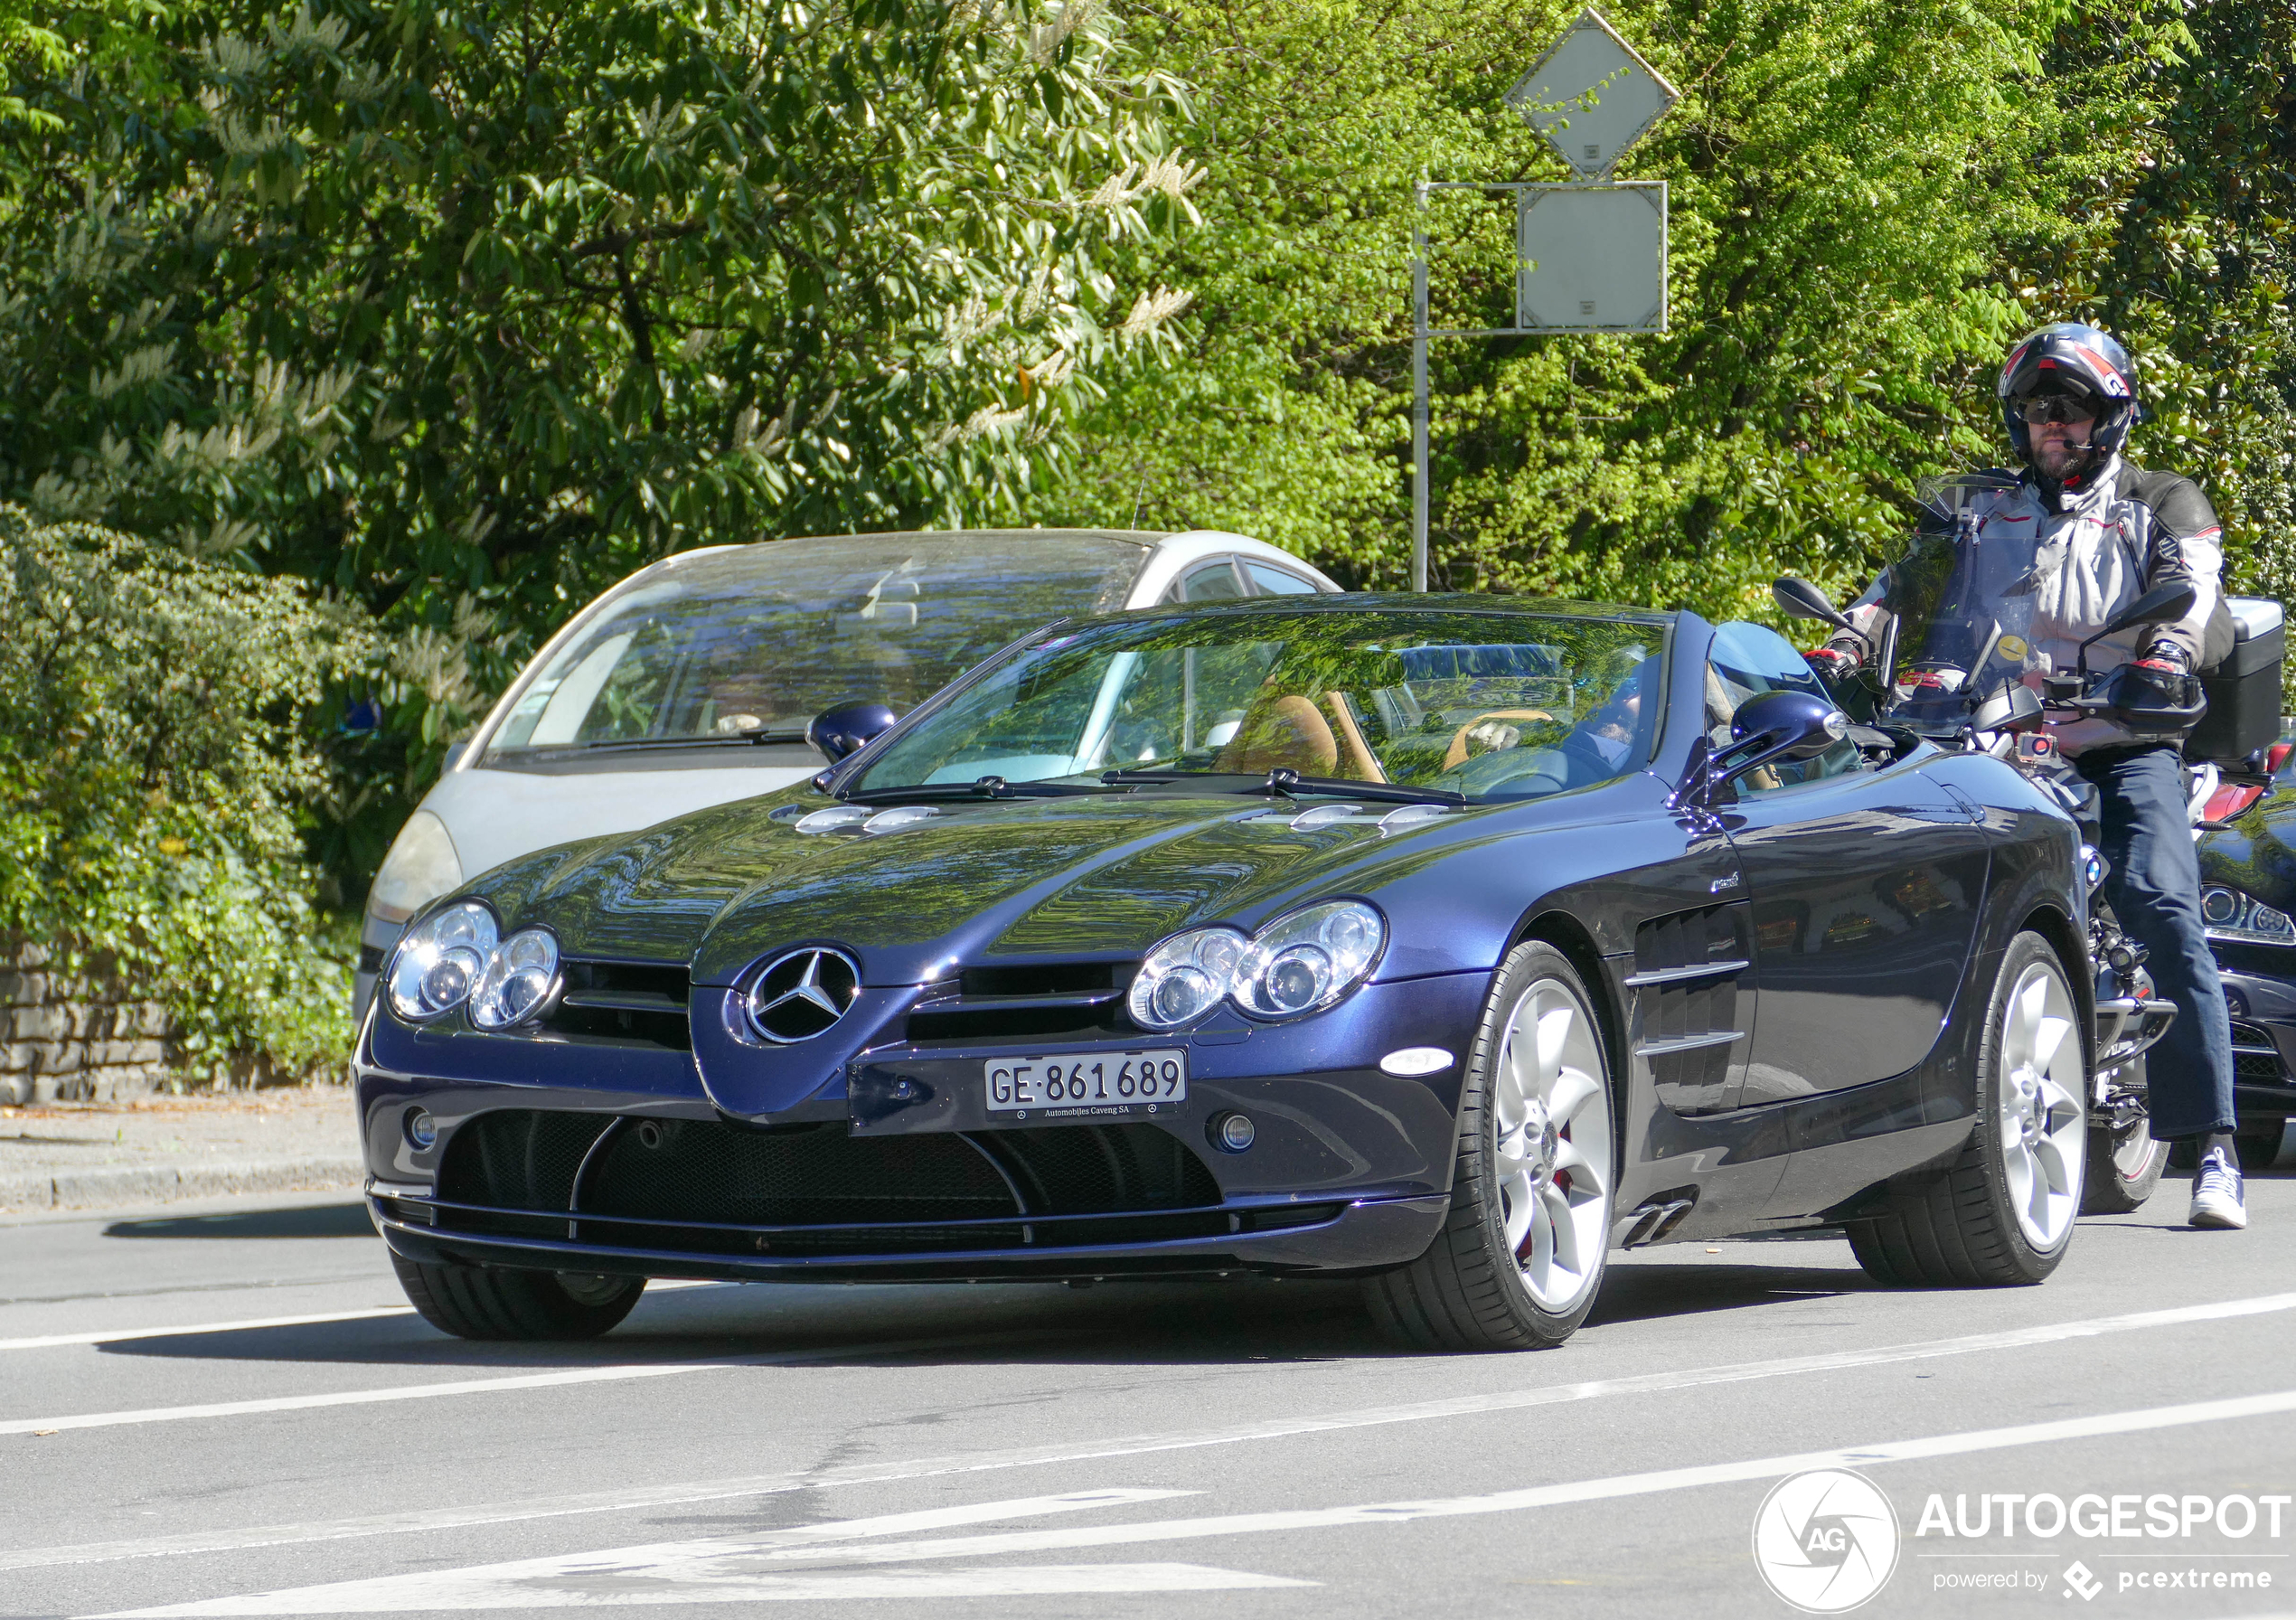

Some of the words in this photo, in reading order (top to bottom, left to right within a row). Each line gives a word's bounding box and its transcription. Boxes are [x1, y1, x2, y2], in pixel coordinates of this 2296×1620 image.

[1045, 1107, 1090, 1117] Automobiles
[1090, 1107, 1117, 1116] Caveng
[1118, 1105, 1130, 1114] SA
